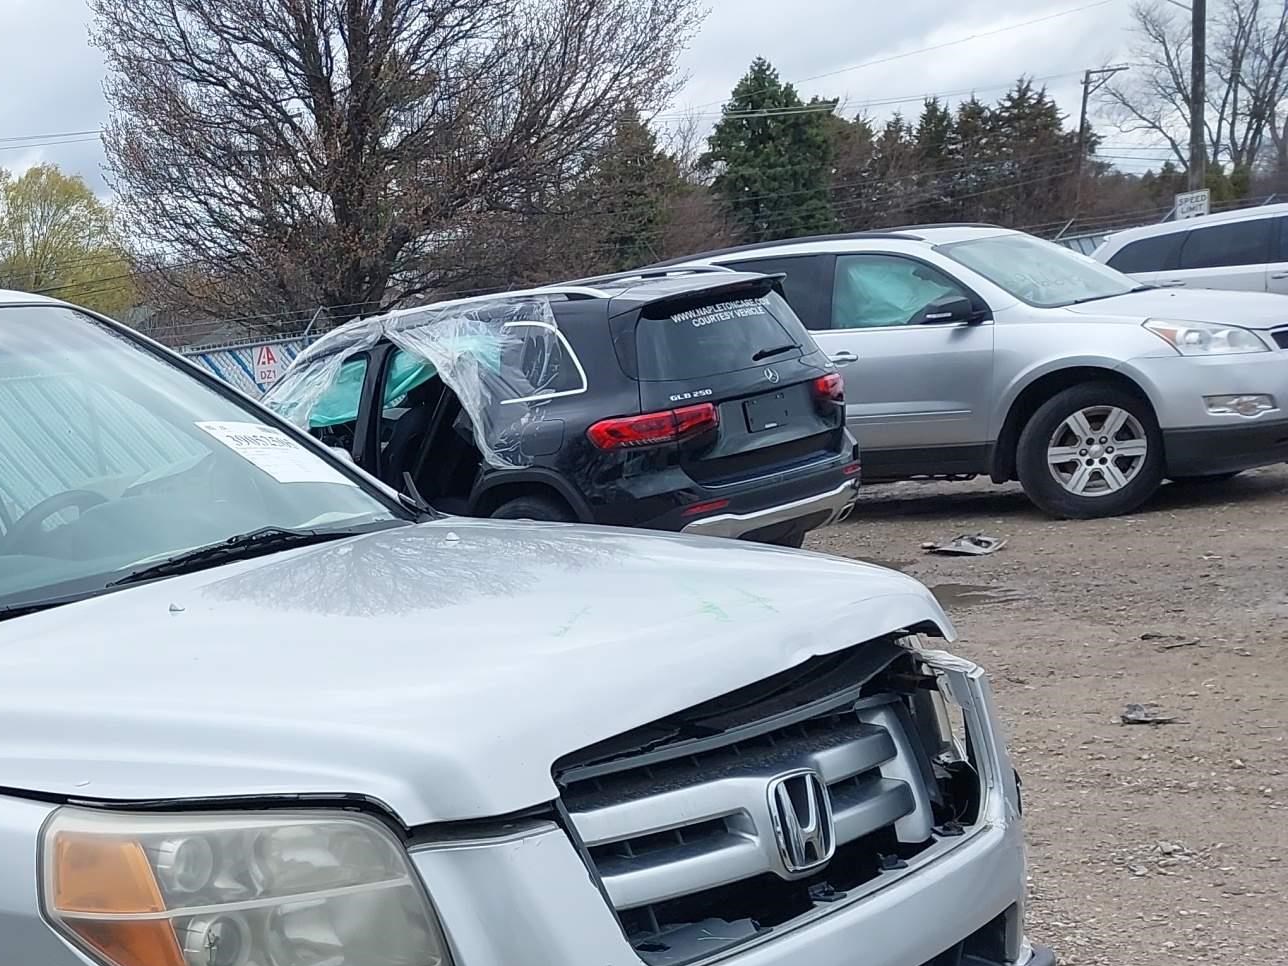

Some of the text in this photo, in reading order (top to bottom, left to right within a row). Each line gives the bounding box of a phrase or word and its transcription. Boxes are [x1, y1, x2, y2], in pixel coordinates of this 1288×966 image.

[1179, 195, 1207, 208] SPEED
[1181, 203, 1204, 214] LIMIT
[670, 297, 770, 323] WWW.NAPLETONCARE.COM
[692, 306, 765, 327] COURTESY VEHICLE
[260, 369, 277, 380] DZ1
[692, 388, 713, 398] 250
